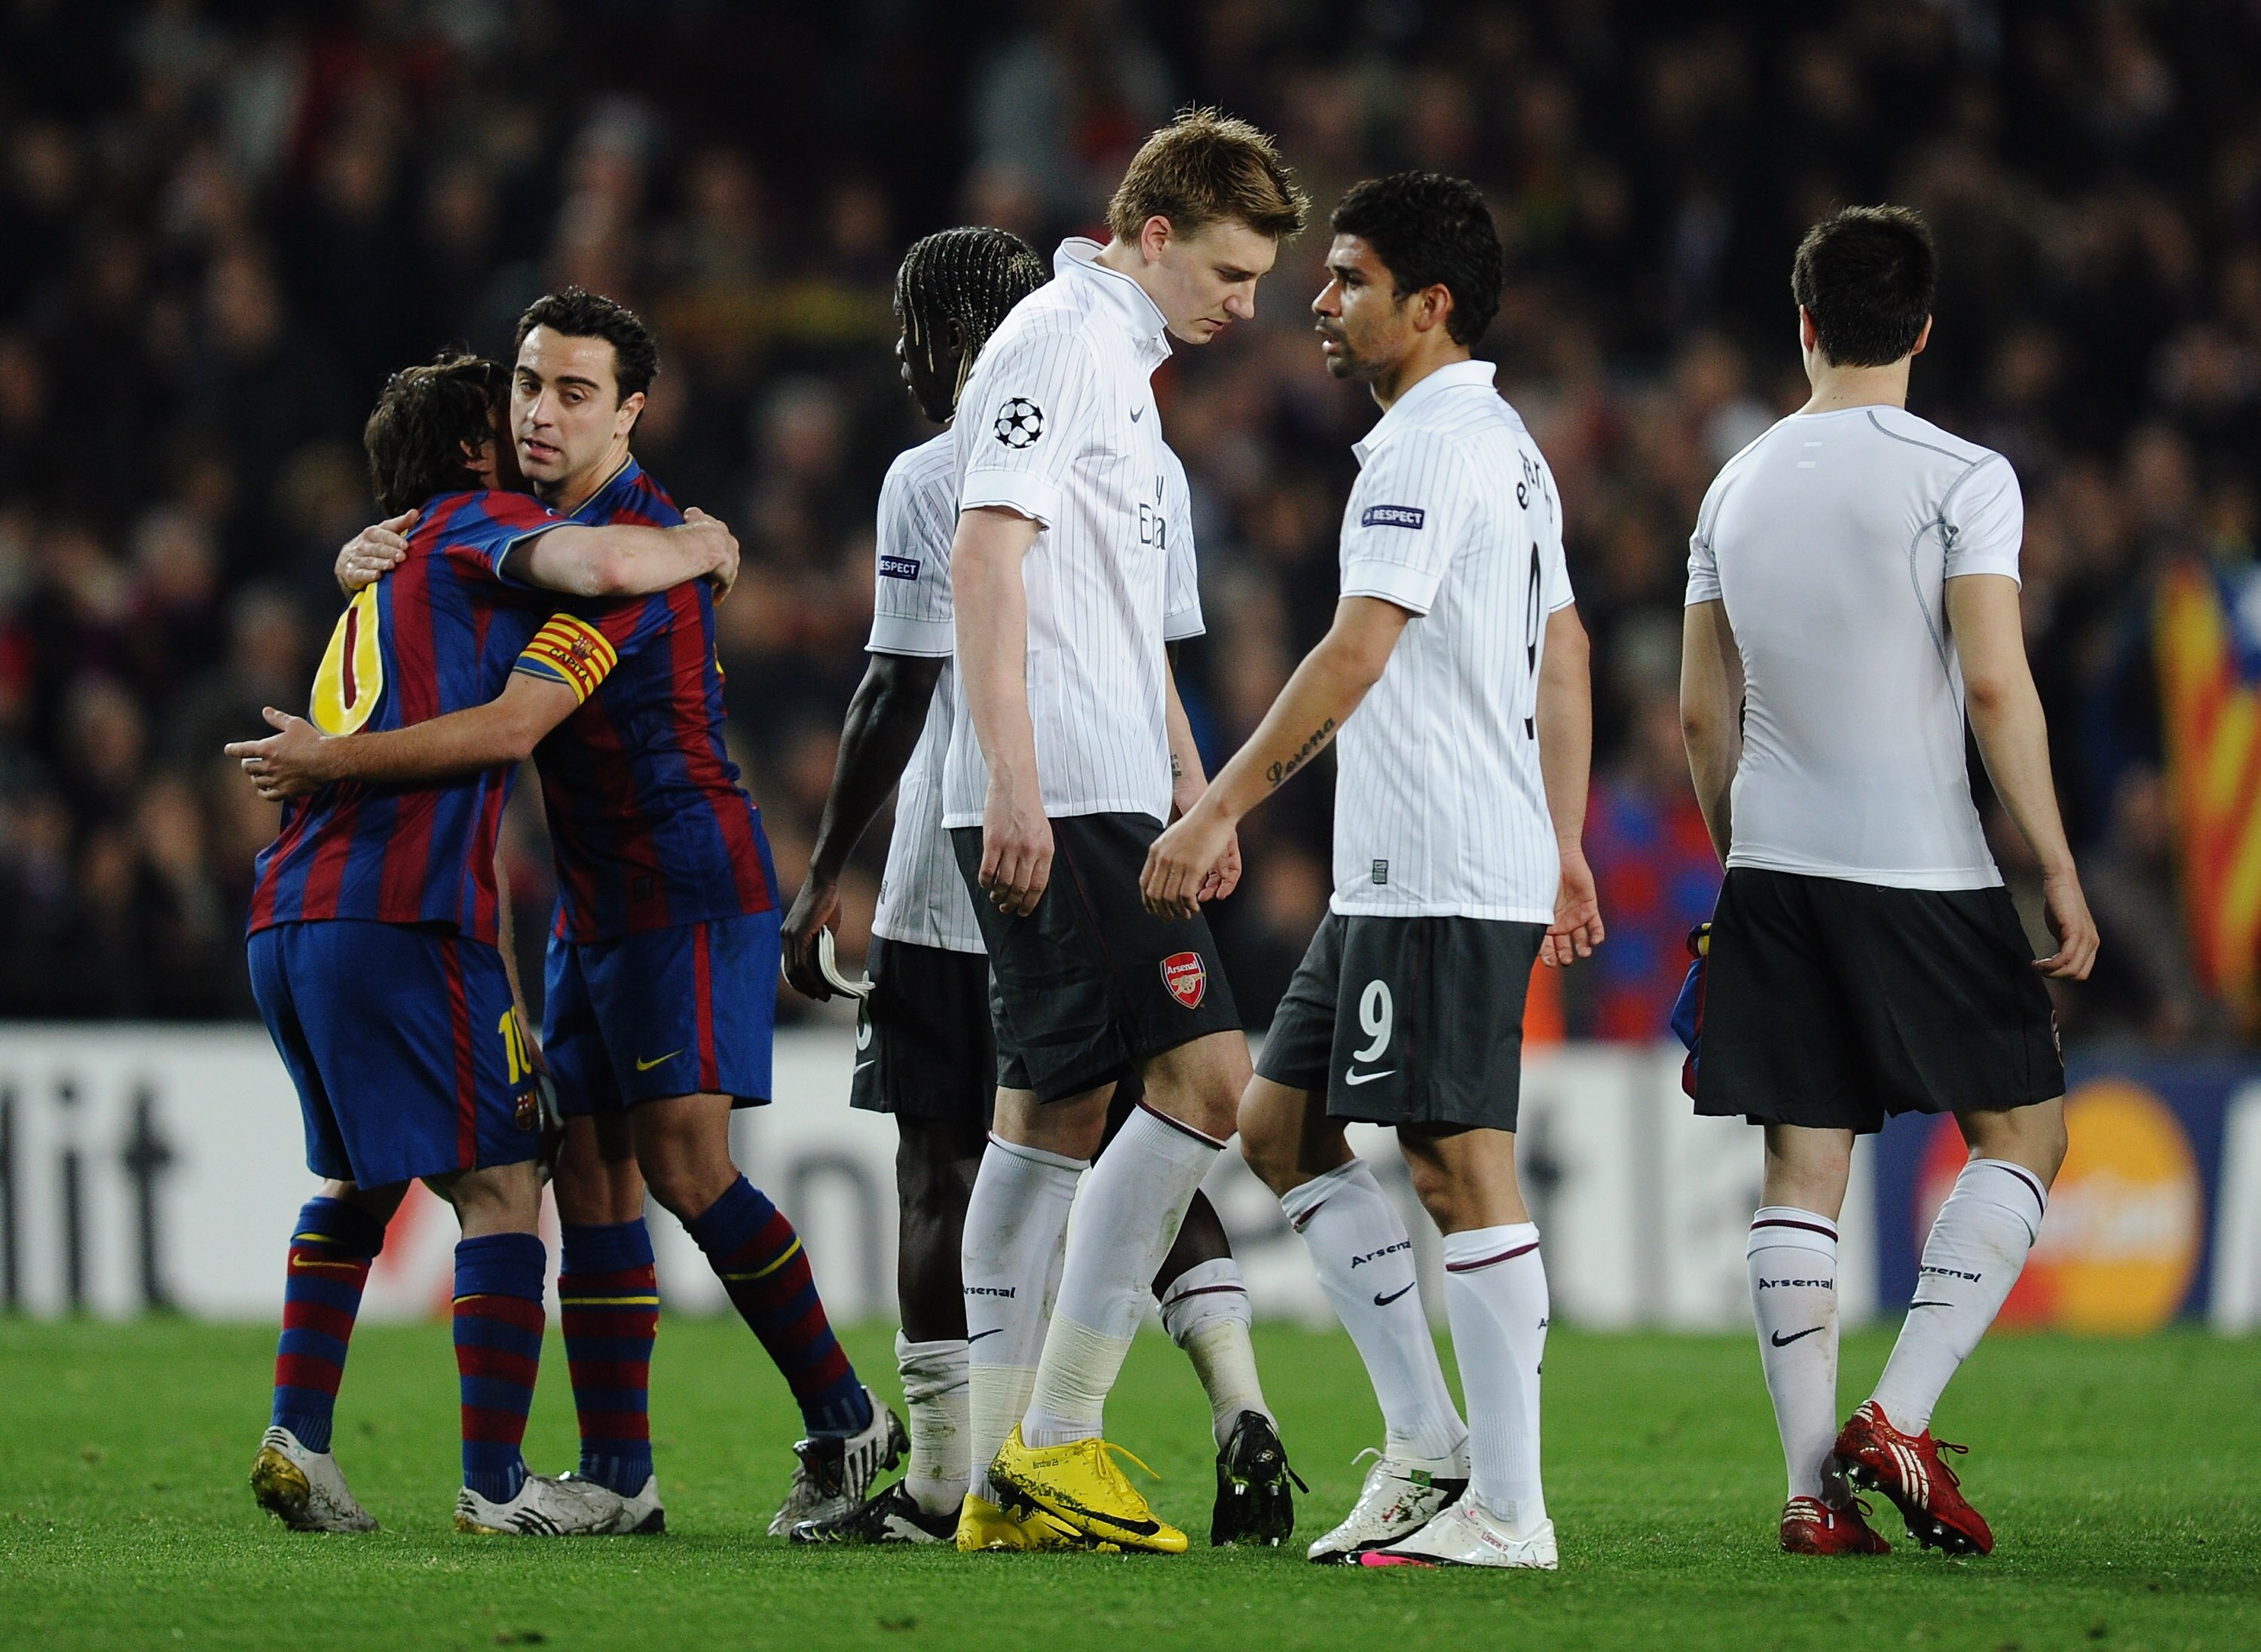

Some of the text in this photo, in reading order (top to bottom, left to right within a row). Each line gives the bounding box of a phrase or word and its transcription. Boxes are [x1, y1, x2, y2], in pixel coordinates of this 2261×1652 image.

[1372, 509, 1422, 525] RESPECT
[1267, 717, 1336, 784] Lorena
[1167, 960, 1198, 974] Arsenal
[1353, 979, 1393, 1063] 9
[1759, 1277, 1834, 1290] Arsenal
